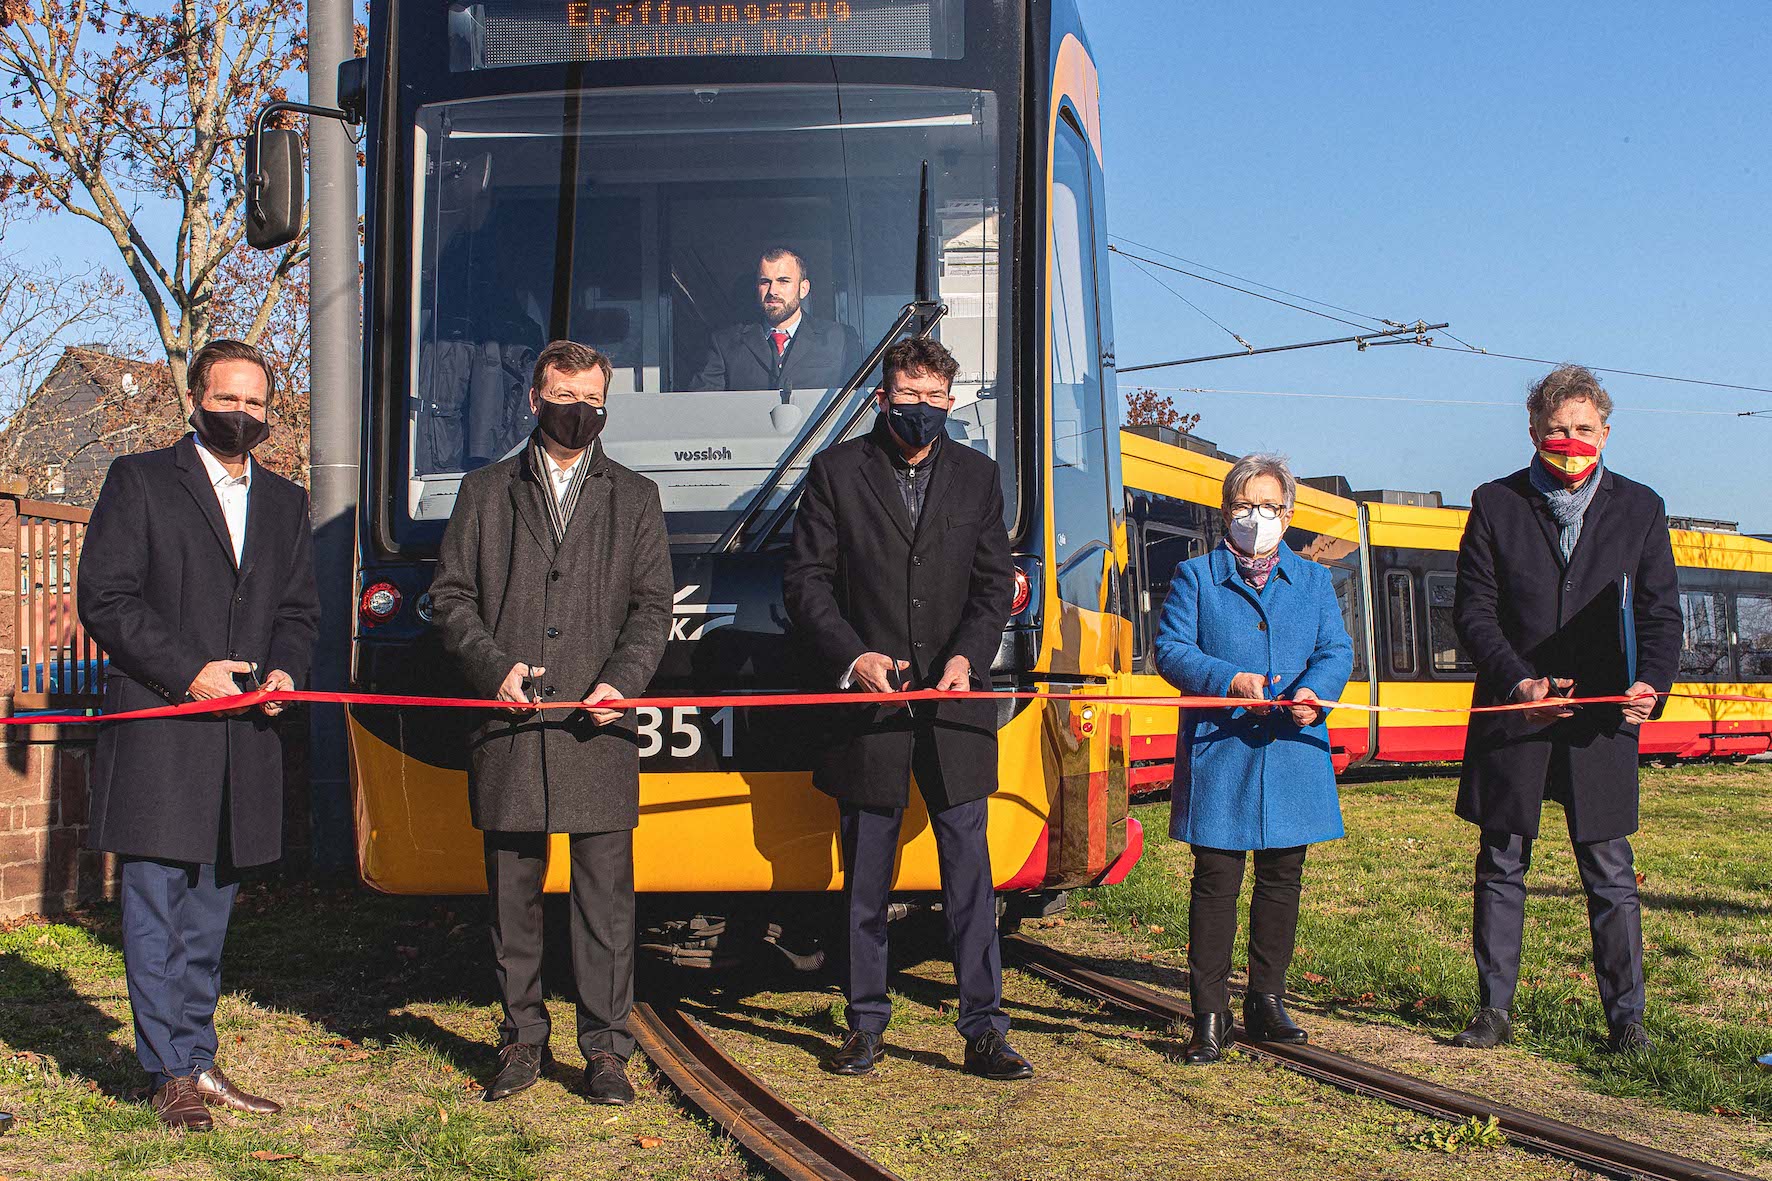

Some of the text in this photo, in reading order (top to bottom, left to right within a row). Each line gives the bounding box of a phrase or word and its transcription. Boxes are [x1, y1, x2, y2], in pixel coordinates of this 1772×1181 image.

[567, 0, 851, 27] Eröffnungszug
[763, 27, 832, 53] Nord
[674, 446, 732, 461] vossloh
[636, 705, 734, 758] 351
